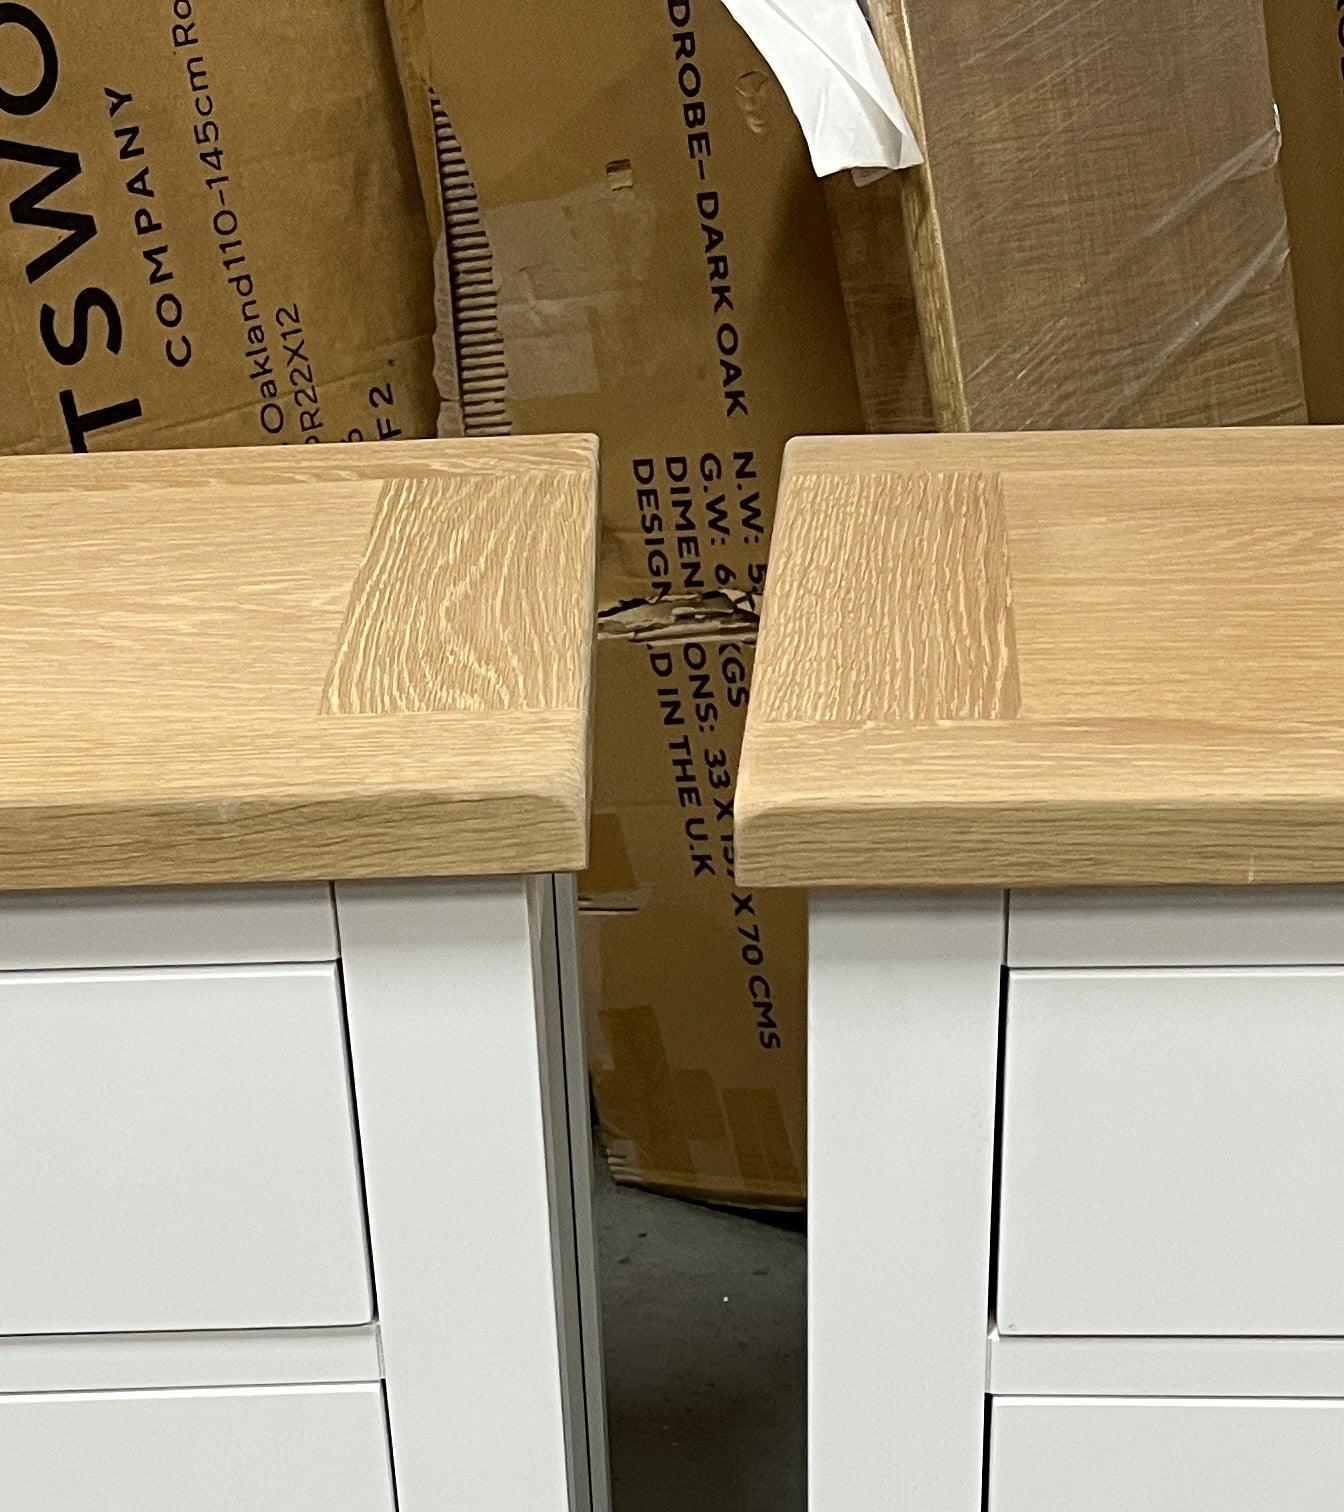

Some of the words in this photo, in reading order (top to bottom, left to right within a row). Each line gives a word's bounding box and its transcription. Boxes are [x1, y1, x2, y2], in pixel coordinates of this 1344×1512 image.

[104, 87, 191, 367] COMPANY
[696, 191, 734, 314] DARK
[717, 323, 749, 417] OAK
[369, 383, 394, 409] 2
[700, 453, 730, 545] G.W:
[733, 452, 764, 543] N.W:
[665, 456, 718, 733] DIMENONS:
[657, 688, 685, 726] IN
[668, 735, 702, 808] THE
[704, 749, 731, 789] 33
[713, 798, 734, 821] X
[684, 817, 716, 876] U.K
[731, 893, 755, 916] X
[738, 925, 763, 966] 70
[749, 976, 781, 1050] CMS
